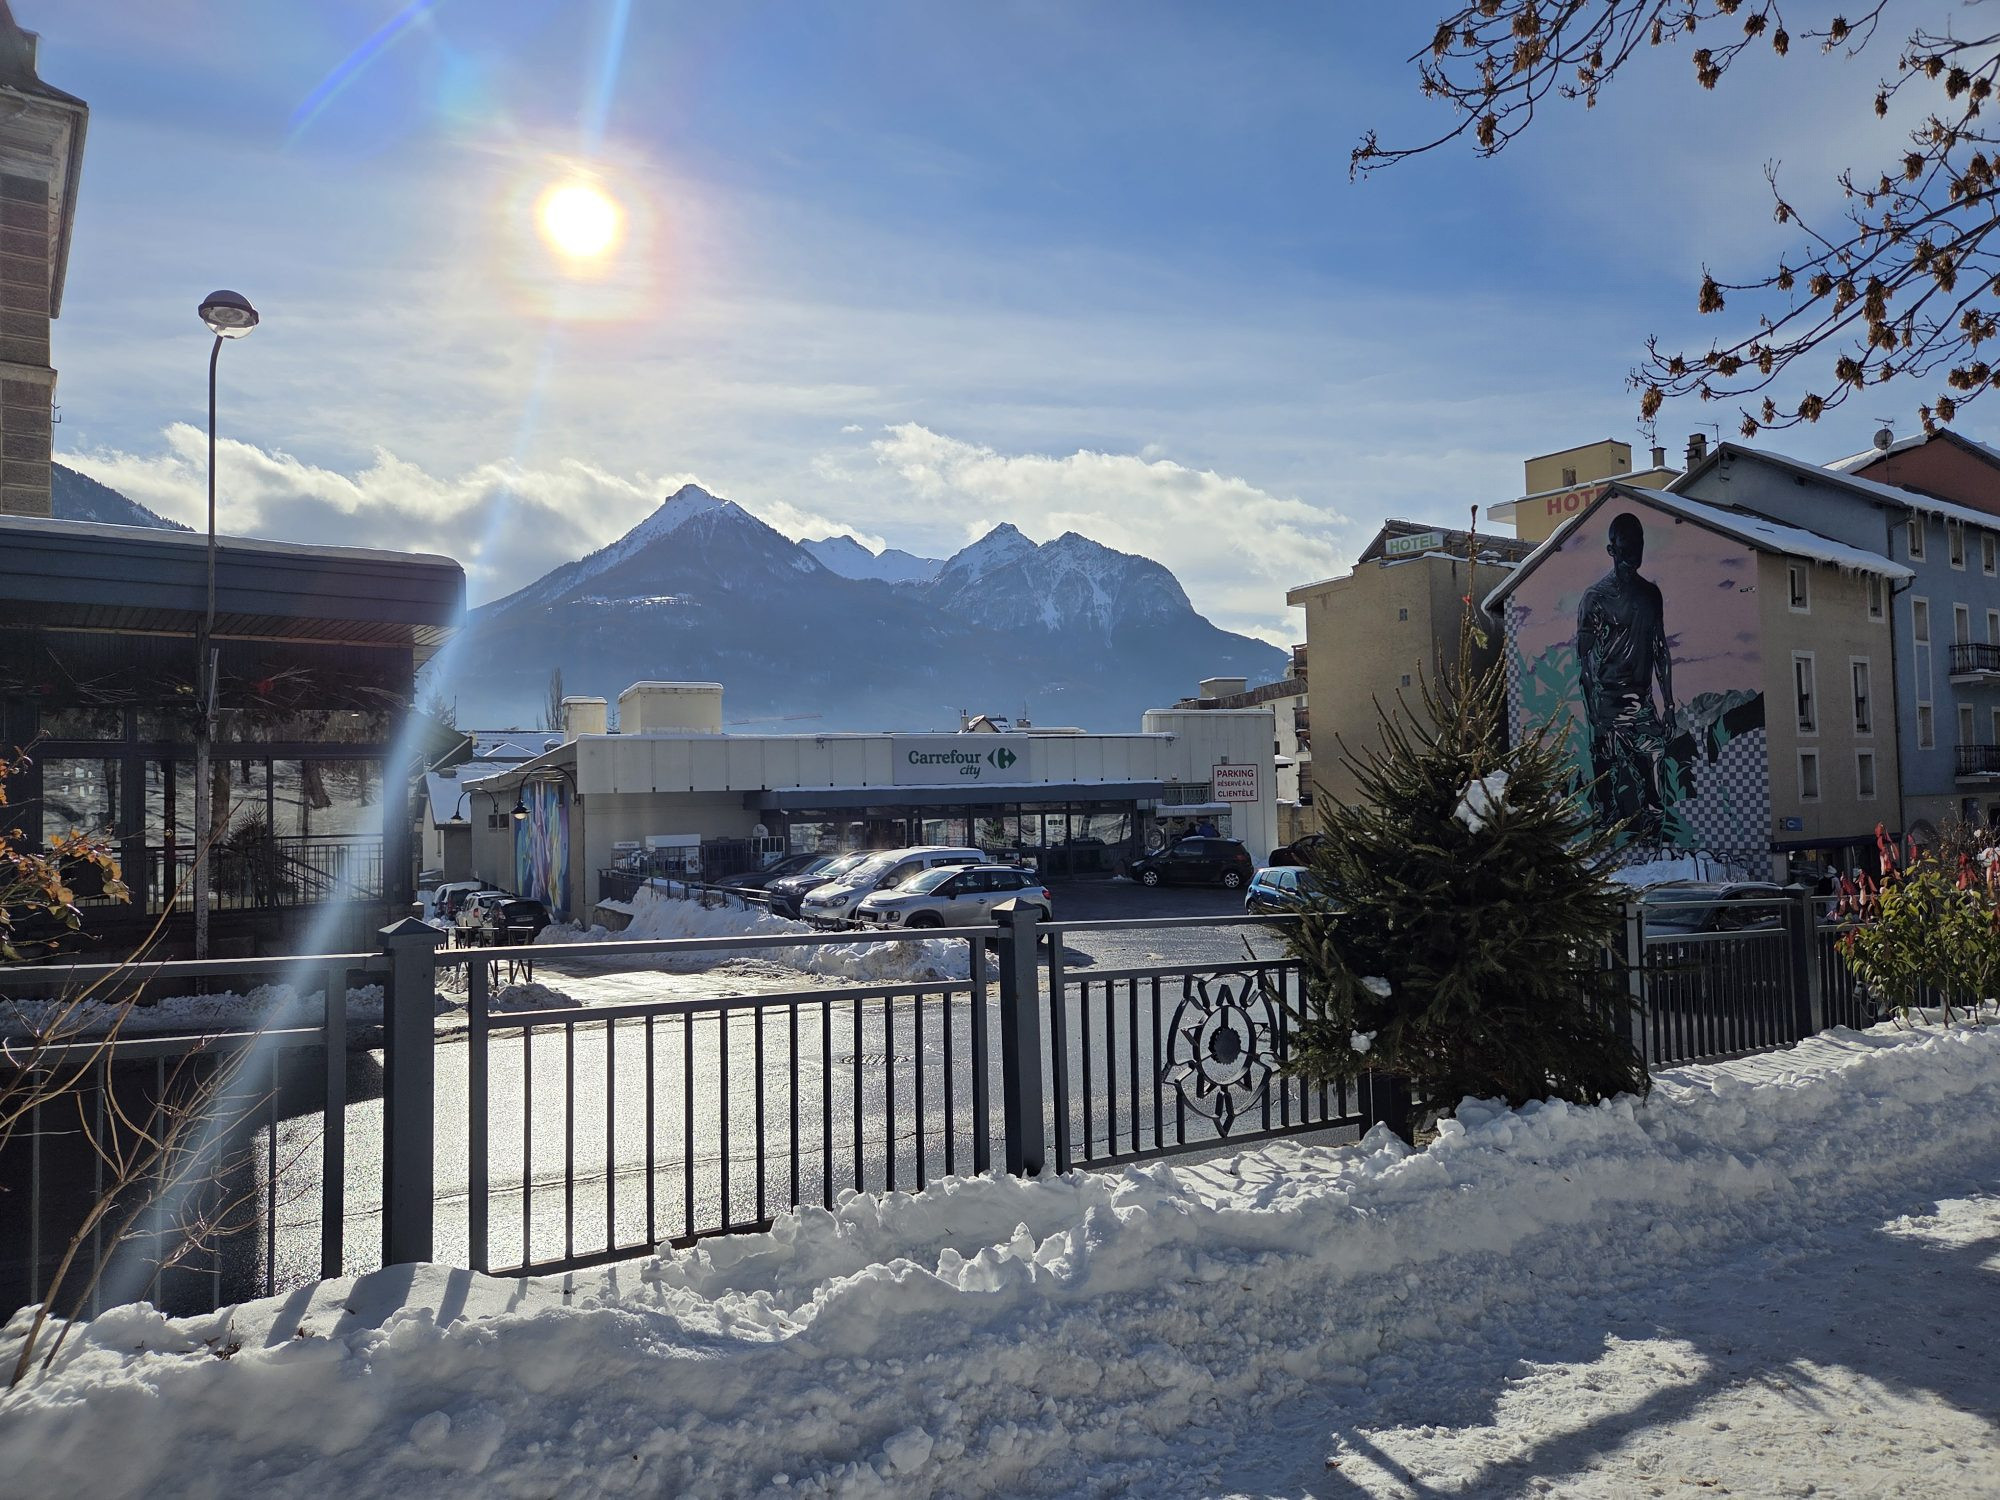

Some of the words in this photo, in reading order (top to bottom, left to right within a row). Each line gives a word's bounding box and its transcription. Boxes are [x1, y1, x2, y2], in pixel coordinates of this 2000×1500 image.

[1390, 534, 1438, 553] HOTEL
[908, 749, 981, 765] Carrefour
[960, 765, 981, 779] city
[1217, 769, 1254, 777] PARKING
[1218, 788, 1254, 797] CLIENTÈLE
